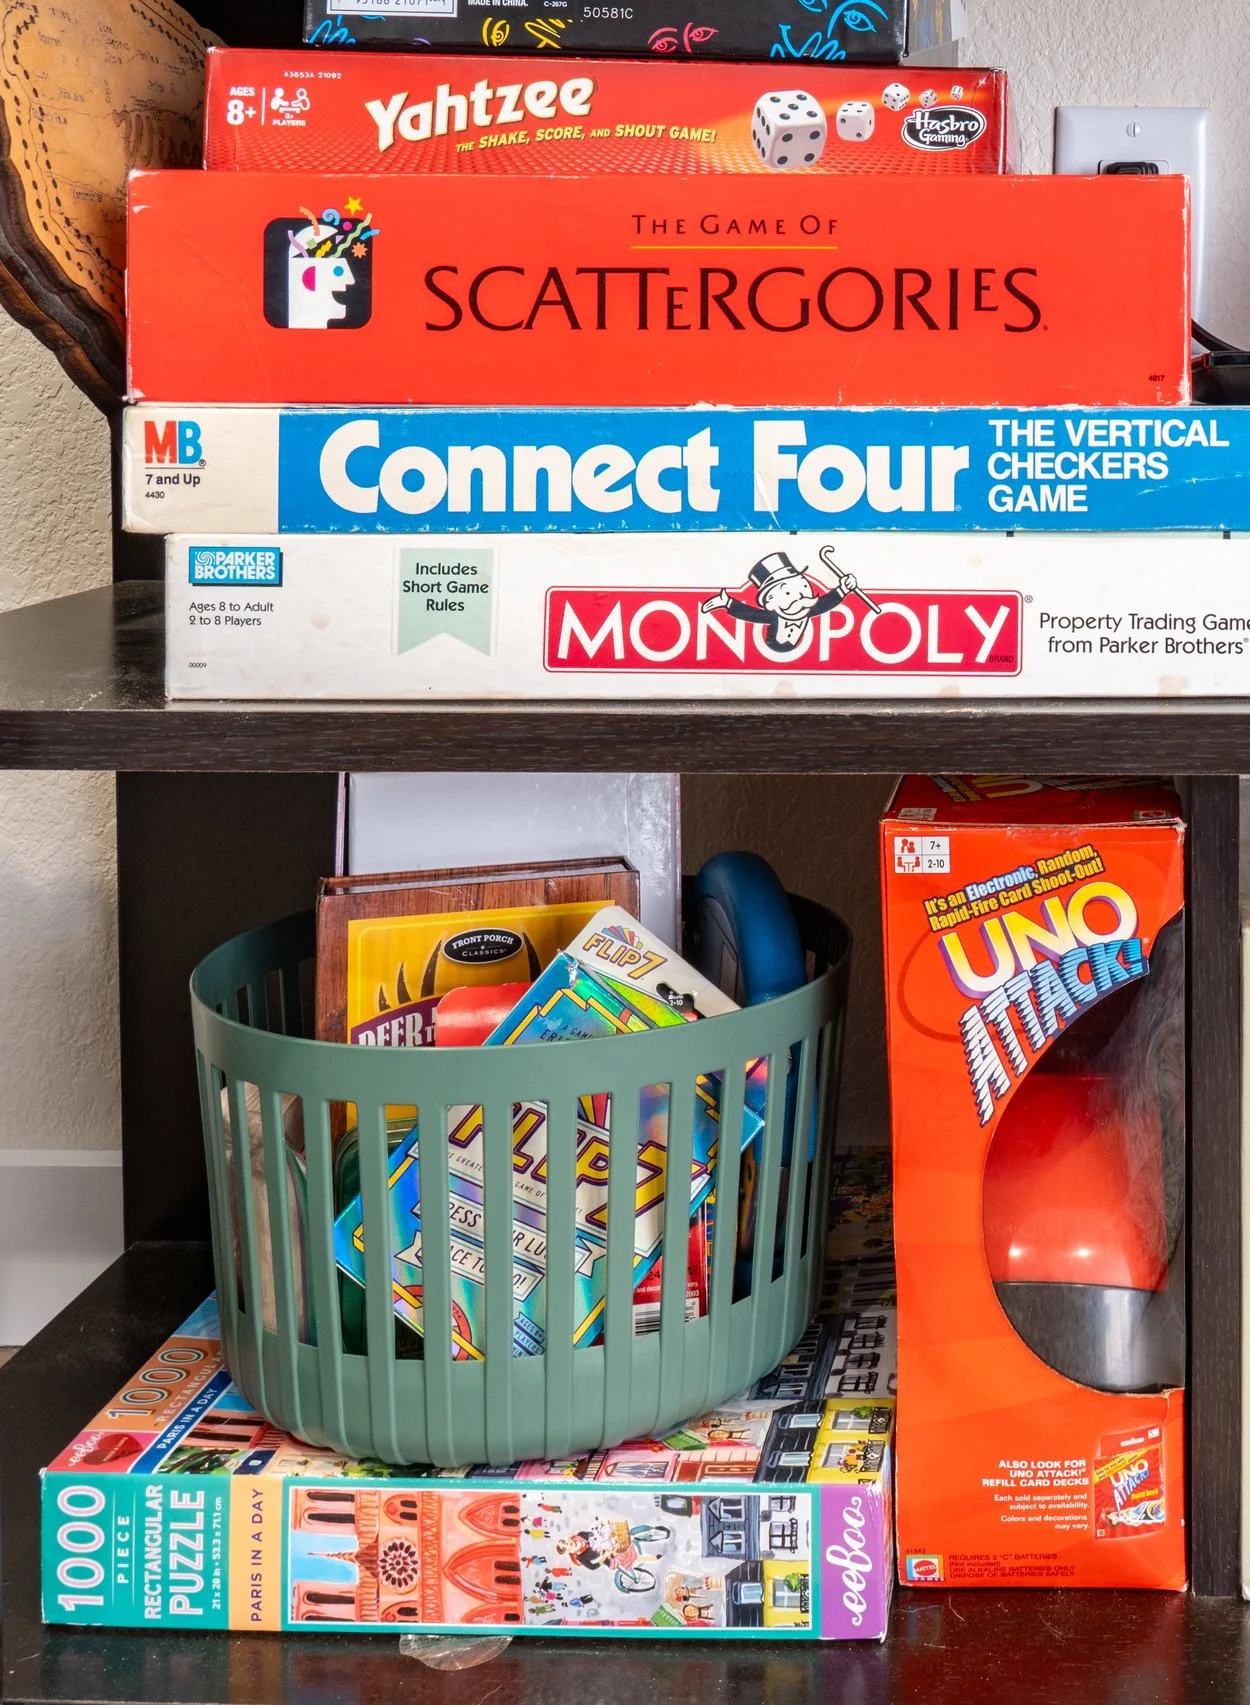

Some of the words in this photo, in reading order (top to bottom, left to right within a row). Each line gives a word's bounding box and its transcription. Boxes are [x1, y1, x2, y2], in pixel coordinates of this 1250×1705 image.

[583, 7, 634, 19] 50581C
[229, 87, 255, 96] AGES
[226, 99, 257, 125] 8+
[365, 77, 594, 153] Yahtzee
[913, 109, 980, 134] Hasbro
[456, 142, 475, 153] THE
[479, 131, 532, 150] SHAKE,
[535, 125, 586, 142] SCORE,
[590, 128, 610, 138] AND
[615, 124, 665, 139] SHOUT
[669, 125, 717, 143] GAME!
[918, 129, 968, 147] Gaming
[144, 421, 203, 464] MB
[988, 419, 1056, 447] THE
[1064, 418, 1230, 448] VERTICAL
[319, 419, 720, 515] Connect
[753, 420, 969, 513] Four
[987, 451, 1169, 480] CHECKERS
[145, 491, 165, 499] 4430
[987, 484, 1089, 513] GAME
[214, 551, 275, 566] PARKER
[415, 562, 478, 576] Includes
[194, 565, 276, 580] BROTHERS
[402, 580, 442, 594] Short
[446, 580, 489, 594] Game
[189, 602, 216, 613] Ages
[219, 602, 225, 611] 8
[229, 603, 240, 611] to
[243, 601, 274, 612] Adult
[425, 598, 465, 613] Rules
[189, 615, 196, 625] 2
[199, 616, 211, 625] to
[214, 616, 221, 625] 8
[224, 615, 262, 628] Players
[1040, 612, 1123, 632] Property
[1128, 612, 1197, 634] Trading
[1048, 635, 1092, 653] from
[1100, 636, 1159, 654] Parker
[1165, 636, 1245, 655] Brothers
[930, 841, 941, 850] 7+
[927, 859, 945, 869] 2-10
[937, 881, 1140, 1000] UNO
[462, 948, 505, 958] CLASSICS
[583, 932, 638, 972] FLIP
[627, 952, 668, 981] 7
[958, 937, 1146, 1129] ATTACK!
[107, 1348, 205, 1421] 1000
[998, 1460, 1028, 1469] ALSO
[1030, 1460, 1061, 1469] LOOK
[1064, 1459, 1086, 1468] FOR
[1009, 1470, 1034, 1478] UNO
[982, 1478, 1016, 1487] REFILL
[1020, 1478, 1050, 1487] CARD
[1053, 1477, 1089, 1487] DECKS
[57, 1485, 105, 1612] 1000
[117, 1515, 129, 1584] PIECE
[144, 1484, 163, 1620] RECTANGULAR
[169, 1490, 204, 1616] PUZZLE
